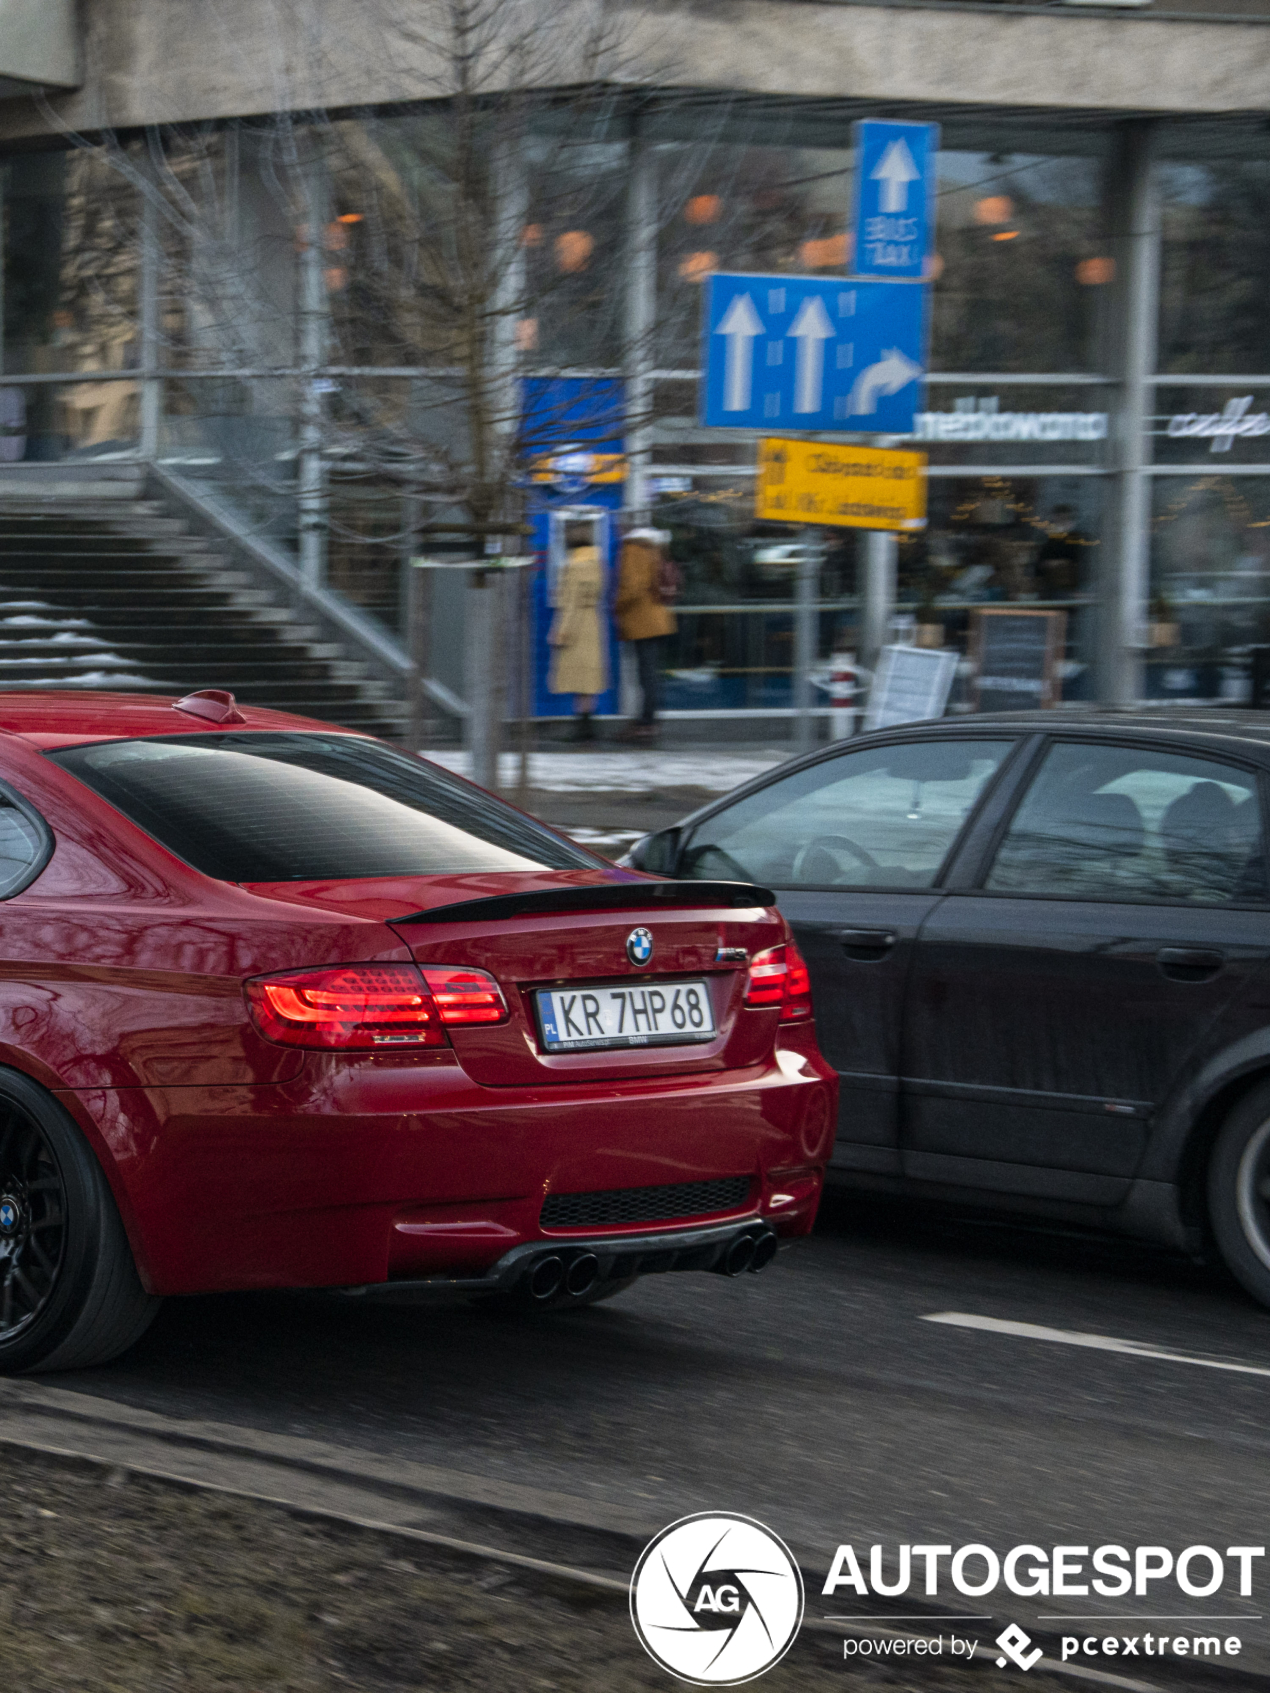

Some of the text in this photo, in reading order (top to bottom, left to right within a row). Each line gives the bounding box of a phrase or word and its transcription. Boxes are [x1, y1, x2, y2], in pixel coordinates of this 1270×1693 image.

[864, 216, 918, 241] BUS
[559, 988, 704, 1038] KR 7HP68
[544, 1023, 557, 1036] PL
[628, 1036, 648, 1045] BMW
